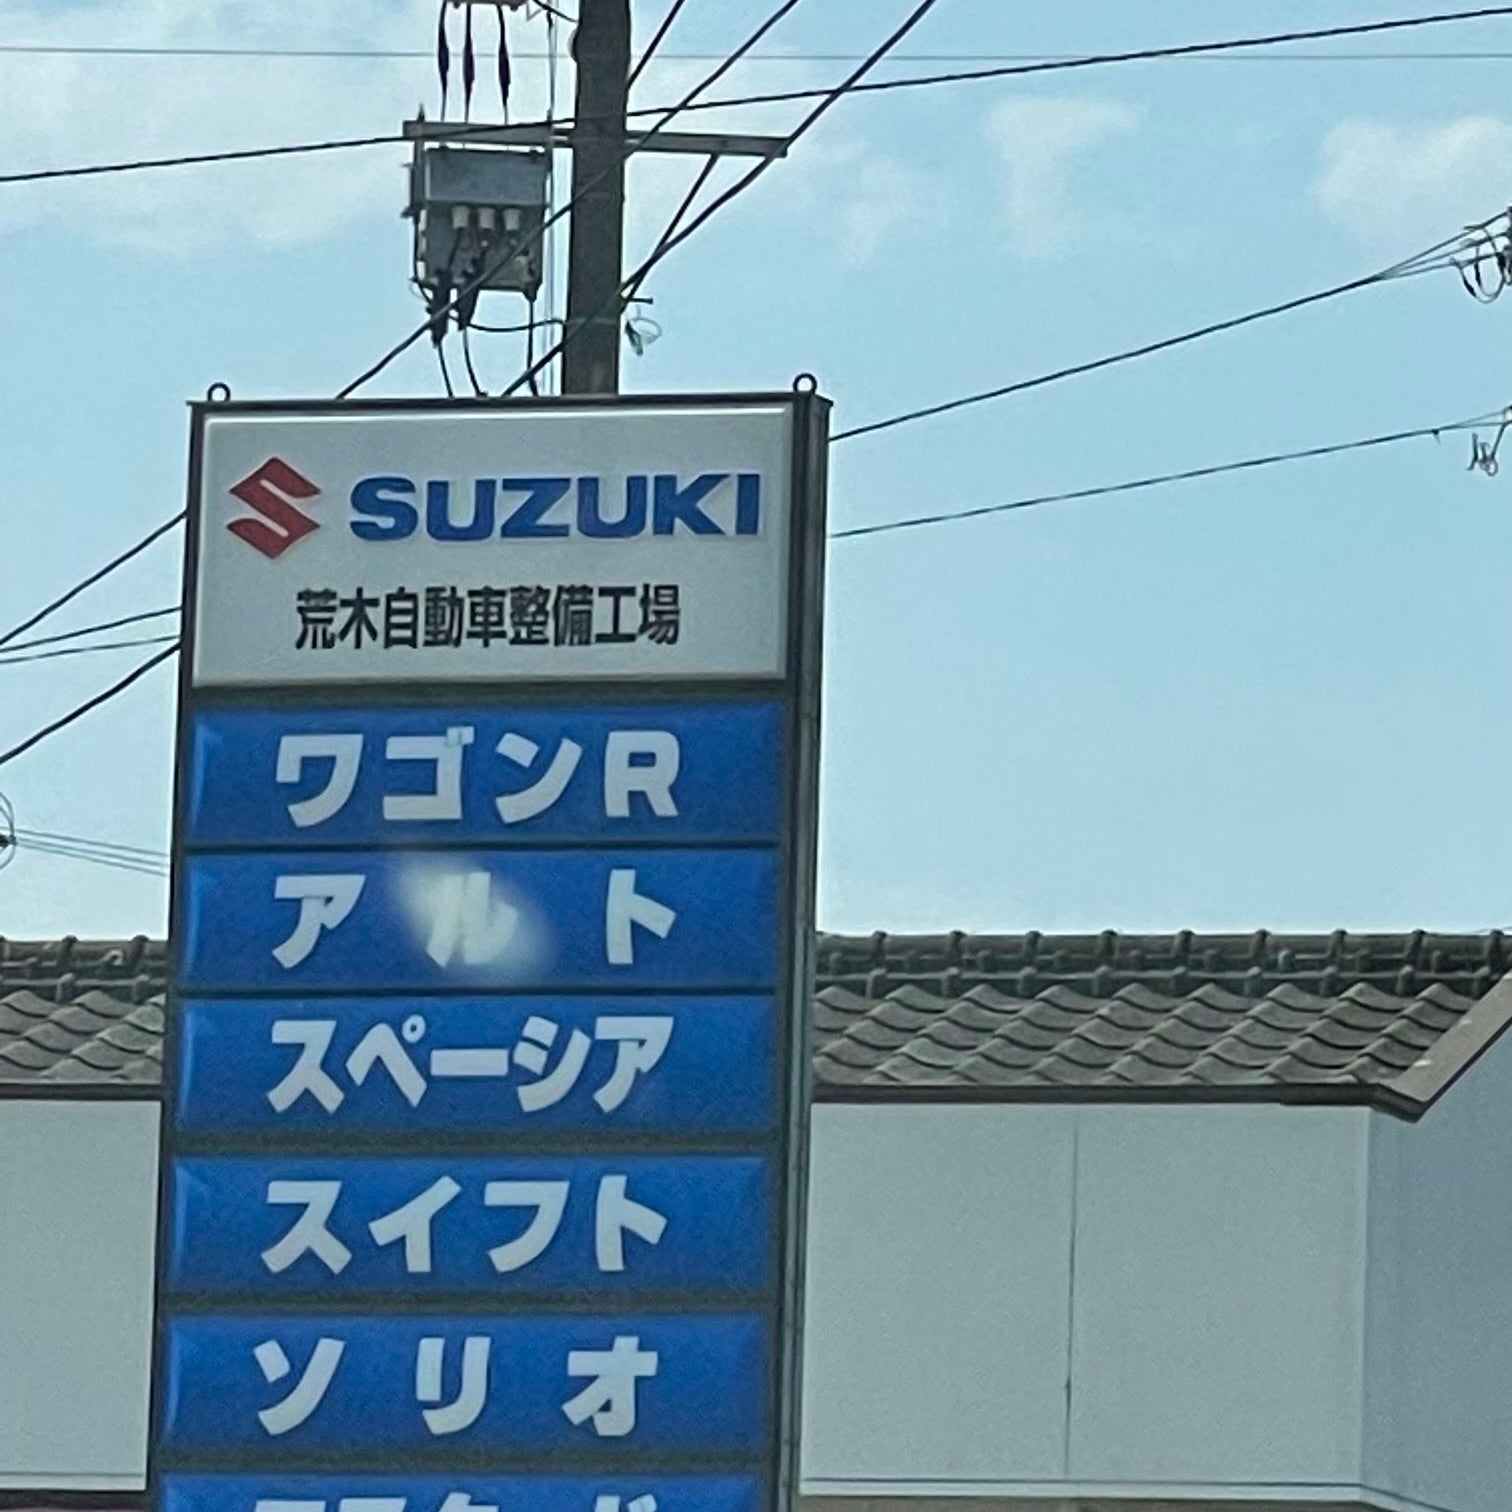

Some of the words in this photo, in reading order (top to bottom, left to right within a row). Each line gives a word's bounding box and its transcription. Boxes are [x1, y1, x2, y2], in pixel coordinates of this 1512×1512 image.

[349, 472, 761, 543] SUZUKI
[295, 583, 681, 651] 荒木自動車整備工場
[275, 725, 681, 829] ワゴンR
[271, 867, 677, 969] アルト
[266, 1015, 675, 1115] スペーシア
[260, 1174, 668, 1275] スイフト
[253, 1334, 659, 1437] ソリオ
